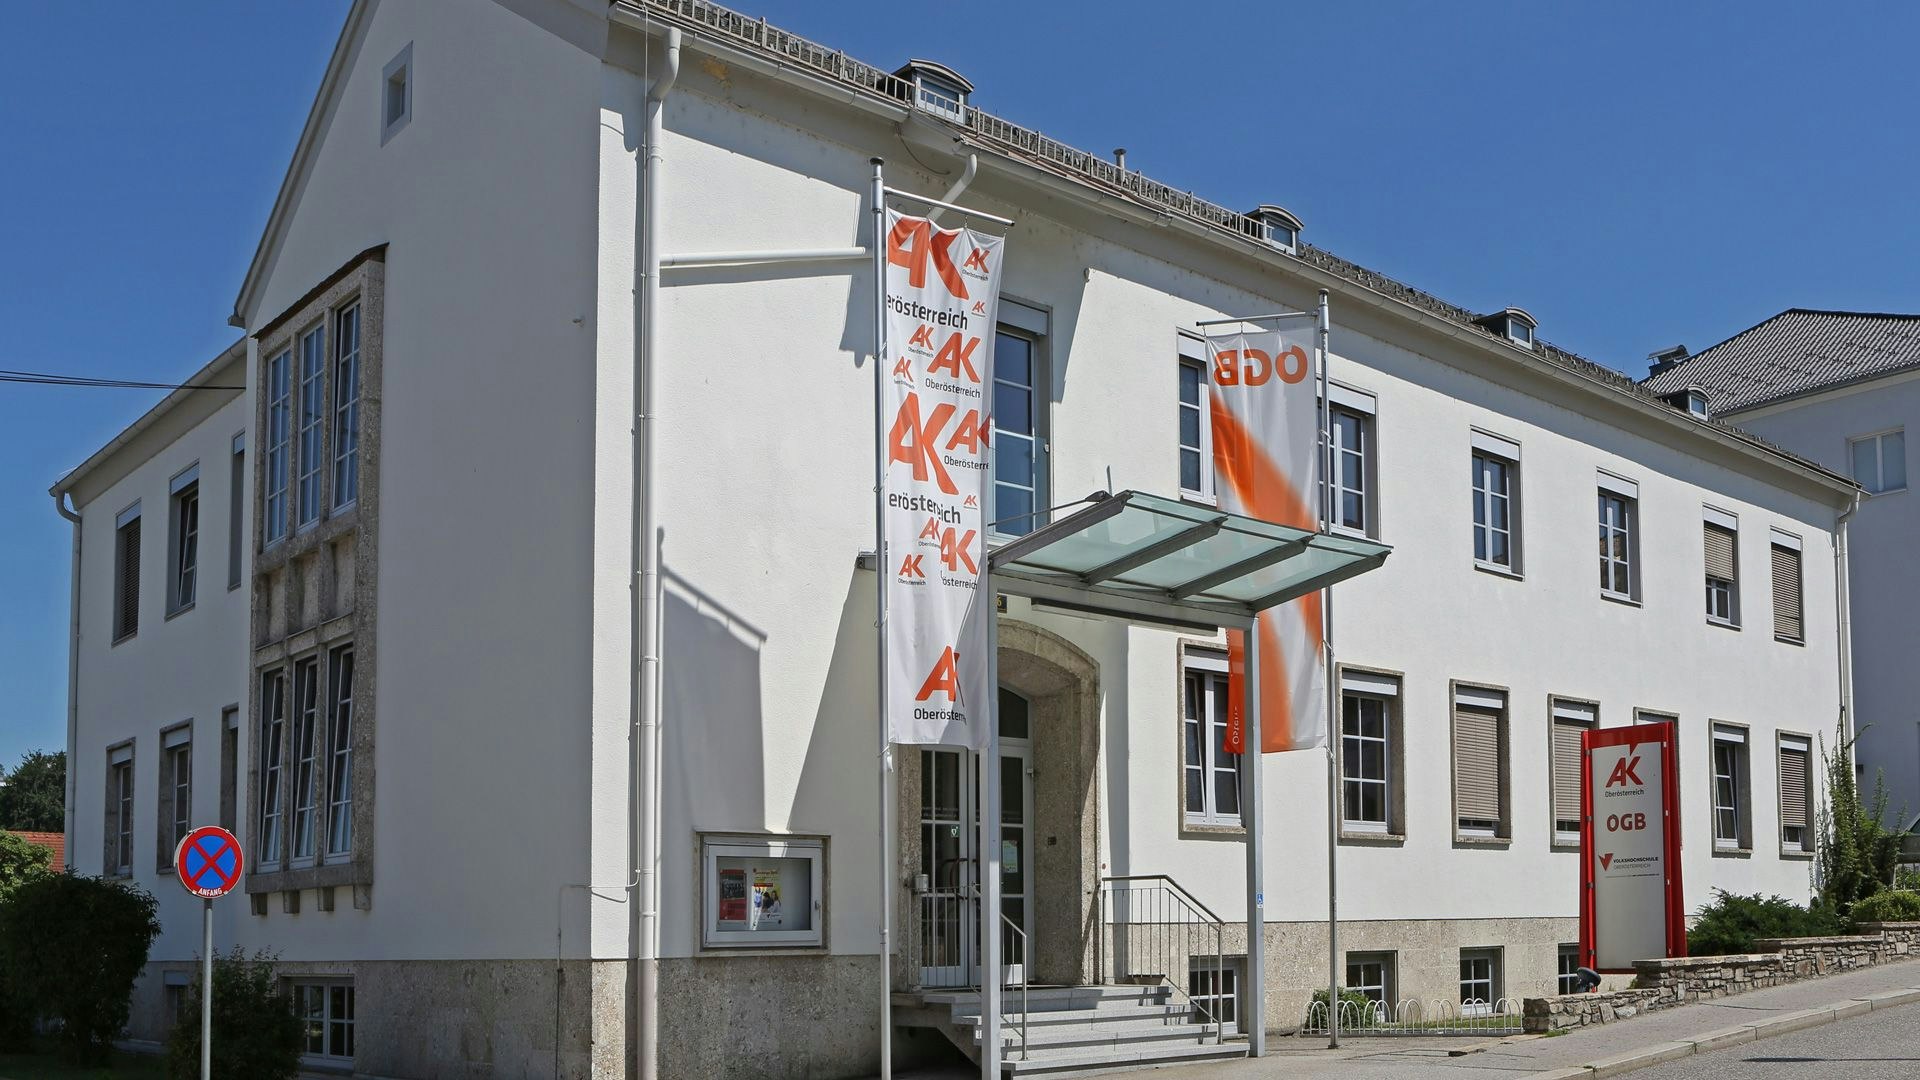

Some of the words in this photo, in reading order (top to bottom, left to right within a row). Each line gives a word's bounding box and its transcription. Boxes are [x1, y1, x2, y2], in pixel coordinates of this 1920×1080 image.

[888, 217, 969, 300] AK
[963, 247, 990, 273] AK
[972, 301, 985, 314] AK
[909, 324, 934, 350] AK
[893, 356, 914, 383] AK
[927, 332, 981, 383] AK
[925, 378, 981, 398] Oberösterreich
[888, 391, 960, 495] AK
[964, 495, 977, 506] AK
[919, 516, 941, 542] AK
[941, 527, 977, 576] AK
[899, 554, 925, 578] AK
[1605, 756, 1644, 788] AK
[1604, 789, 1645, 798] Oberösterreich
[198, 887, 222, 896] ANFANG
